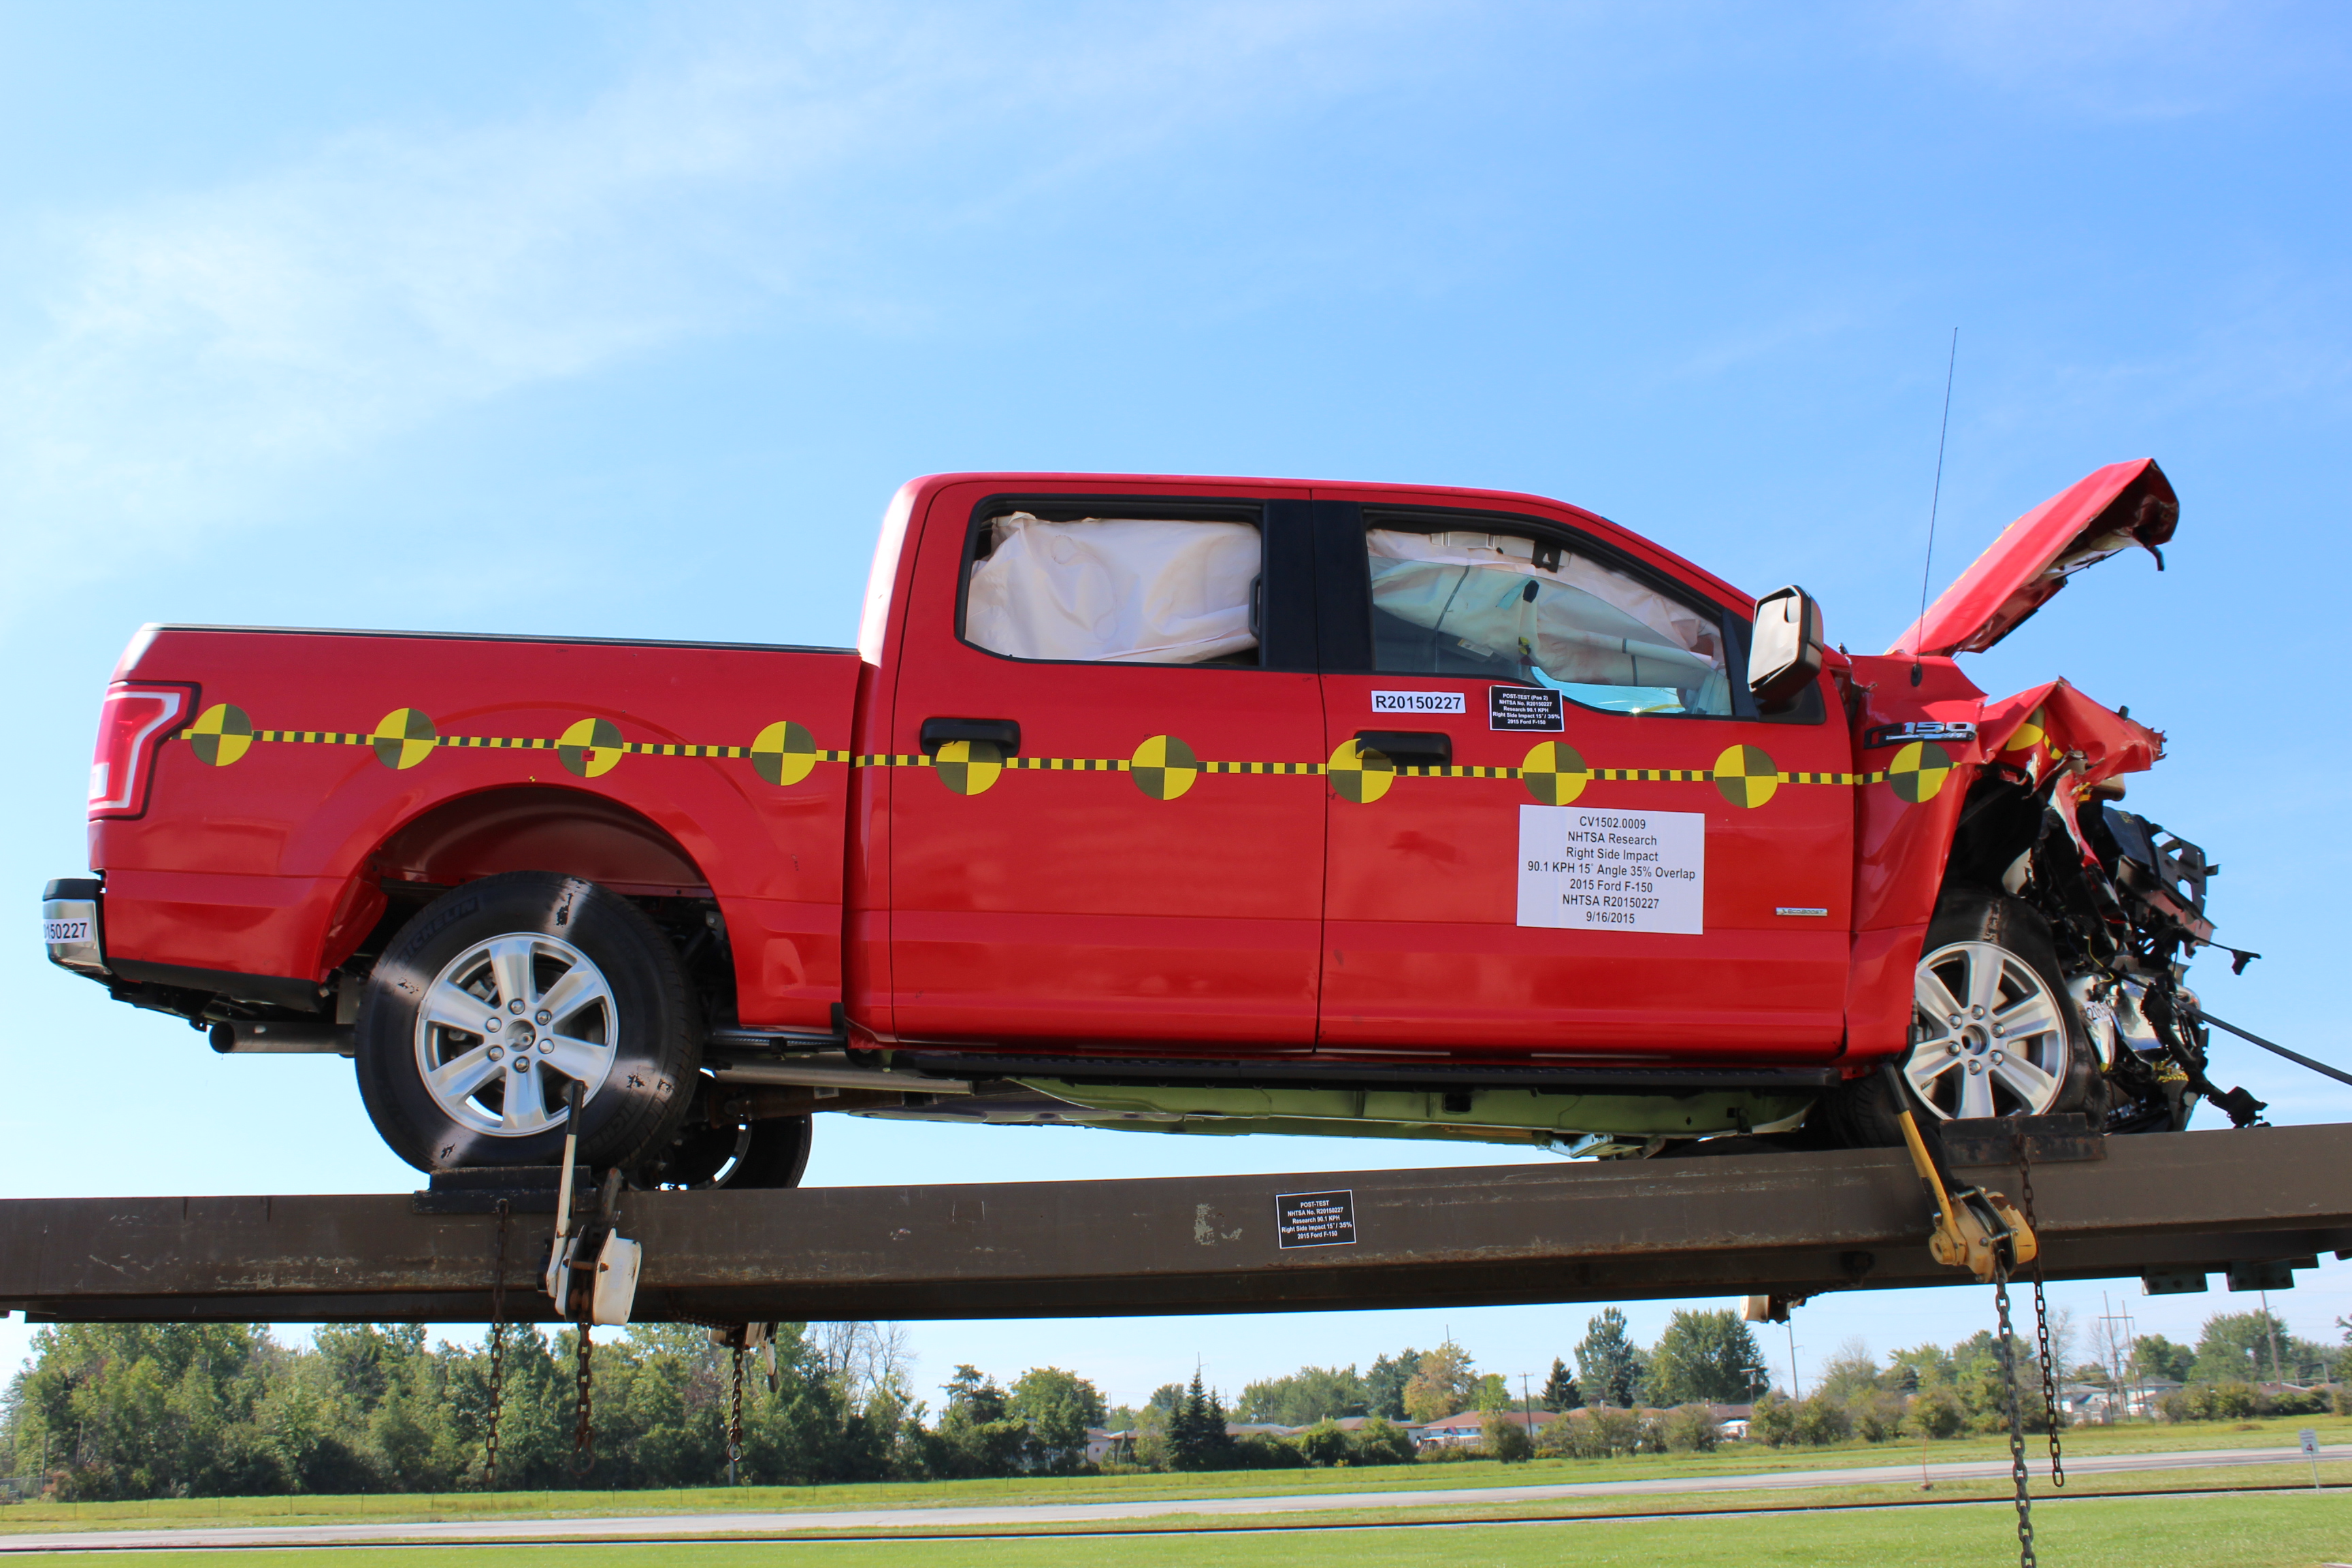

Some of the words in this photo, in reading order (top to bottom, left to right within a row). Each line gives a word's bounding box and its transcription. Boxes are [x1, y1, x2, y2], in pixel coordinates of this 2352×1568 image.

[1375, 696, 1461, 710] R20150227
[1580, 816, 1646, 830] CV1502.0009
[1568, 831, 1605, 843] NHTSA
[1608, 833, 1657, 845] Research
[1567, 847, 1594, 860] Right
[1597, 848, 1620, 859] Side
[1623, 850, 1659, 863] Impact
[1528, 861, 1548, 872] 90.1
[1552, 862, 1575, 873] KPH
[1597, 864, 1627, 878] Angle
[1631, 866, 1652, 877] 35%
[1655, 867, 1695, 881] Overlap
[1570, 879, 1594, 890] 2015
[1597, 880, 1621, 892] Ford
[1625, 881, 1653, 892] F-150
[1563, 894, 1600, 906] NHTSA
[1603, 896, 1659, 909] R20150227
[1586, 911, 1635, 924] 9/16/2015
[1301, 1200, 1329, 1208] POST-TEST
[1316, 1207, 1343, 1215] R20150227
